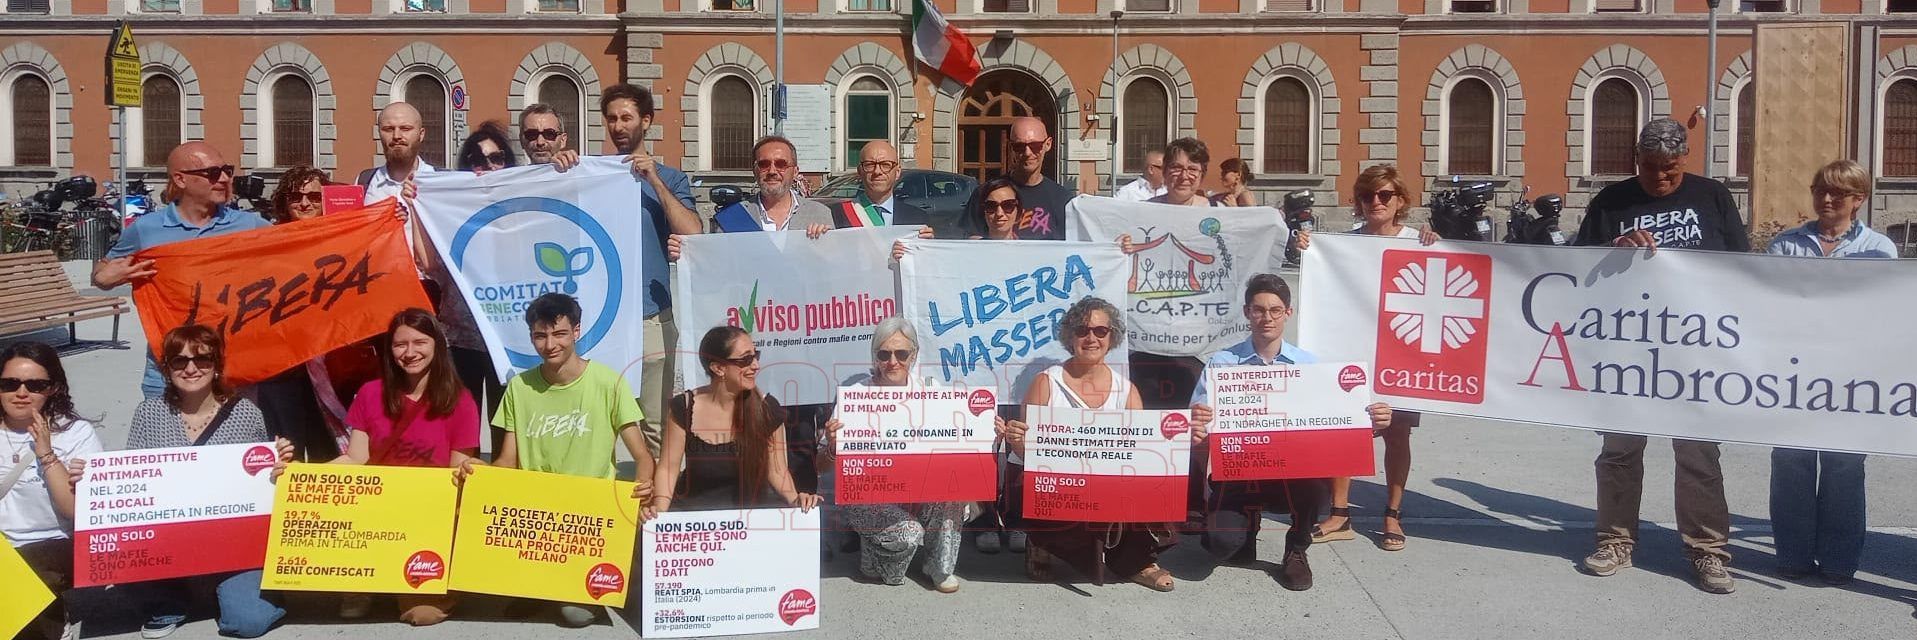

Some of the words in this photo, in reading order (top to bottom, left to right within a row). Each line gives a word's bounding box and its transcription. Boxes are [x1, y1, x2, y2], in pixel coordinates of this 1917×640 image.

[1620, 208, 1699, 235] LIBERA
[928, 255, 1095, 336] LIBERA
[805, 294, 896, 336] pubblico
[1521, 272, 1741, 349] Caritas
[773, 336, 802, 348] Regioni
[804, 336, 828, 345] contro
[858, 334, 873, 342] corr
[938, 308, 1068, 382] MASSER
[1141, 332, 1180, 344] anche
[1183, 335, 1202, 346] per
[1218, 372, 1230, 381] 50
[1232, 370, 1300, 380] INTERDITTIVE
[1517, 321, 1917, 418] Ambrosiana
[1379, 362, 1479, 396] caritas
[1218, 383, 1274, 393] ANTIMAFIA
[844, 392, 890, 400] MINACCE
[892, 392, 904, 400] DI
[906, 392, 938, 400] MORTE
[941, 392, 952, 400] AI
[954, 392, 968, 400] PM
[1218, 396, 1236, 404] NEL
[1238, 396, 1262, 404] 2024
[844, 404, 855, 412] DI
[858, 404, 896, 412] MILANO
[1233, 408, 1268, 416] LOCALI
[1220, 421, 1230, 429] DI
[1296, 418, 1306, 426] IN
[1309, 416, 1352, 426] REGIONE
[844, 430, 881, 438] HYDRA:
[886, 429, 898, 438] 62
[903, 429, 957, 438] CONDANNE
[962, 428, 973, 436] IN
[1037, 424, 1075, 434] HYDRA:
[1078, 426, 1096, 435] 460
[1098, 427, 1140, 436] MILIONI
[1142, 428, 1154, 436] DI
[843, 442, 906, 450] ABBREVIATO
[1036, 436, 1070, 446] DANNI
[1072, 438, 1114, 448] STIMATI
[1116, 440, 1136, 448] PER
[1220, 436, 1242, 445] NON
[1244, 436, 1270, 444] SOLO
[1036, 449, 1098, 459] L'ECONOMIA
[1101, 452, 1132, 460] REALE
[1220, 444, 1244, 453] SUD.
[90, 458, 105, 468] 50
[109, 452, 198, 467] INTERDITTIVE
[842, 458, 864, 468] NON
[866, 458, 893, 467] SOLO
[90, 468, 163, 482] ANTIMAFIA
[842, 467, 866, 476] SUD.
[290, 474, 318, 484] NON
[320, 474, 352, 484] SOLO
[356, 476, 384, 486] SUD.
[1035, 476, 1057, 486] NON
[1059, 478, 1086, 487] SOLO
[90, 487, 112, 496] NEL
[116, 484, 147, 494] 2024
[288, 484, 302, 492] LE
[305, 484, 344, 494] MAFIE
[348, 486, 382, 495] SONO
[1035, 484, 1059, 493] SUD.
[90, 501, 104, 511] 24
[109, 497, 154, 509] LOCALI
[286, 494, 328, 504] ANCHE
[332, 495, 359, 506] QUI.
[90, 516, 103, 526] DI
[189, 508, 202, 517] IN
[205, 503, 255, 516] REGIONE
[310, 511, 320, 520] %
[483, 505, 498, 515] LA
[562, 514, 604, 527] CIVILE
[606, 518, 614, 528] E
[283, 520, 352, 530] OPERAZIONI
[492, 516, 506, 526] LE
[510, 518, 602, 537] ASSOCIAZIONI
[655, 523, 682, 532] NON
[685, 522, 717, 532] SOLO
[720, 520, 748, 530] SUD.
[90, 533, 118, 544] NON
[122, 530, 155, 541] SOLO
[282, 529, 340, 540] SOSPETTE,
[342, 531, 406, 541] LOMBARDIA
[486, 526, 536, 540] STANNO
[540, 534, 554, 542] AL
[558, 534, 606, 548] FIANCO
[655, 534, 668, 542] LE
[672, 532, 710, 542] MAFIE
[714, 531, 748, 541] SONO
[90, 542, 120, 553] SUD.
[280, 538, 314, 548] PRIMA
[317, 539, 329, 548] IN
[332, 540, 368, 549] ITALIA
[485, 536, 522, 549] DELLA
[526, 541, 586, 556] PROCURA
[589, 548, 604, 558] DI
[655, 542, 697, 553] ANCHE
[700, 542, 726, 554] QUI.
[109, 548, 149, 560] MAFIE
[518, 550, 568, 564] MILANO
[90, 560, 126, 572] SONO
[130, 556, 173, 568] ANCHE
[277, 556, 308, 566] 2.616
[655, 560, 668, 568] LO
[672, 558, 714, 568] DICONO
[276, 566, 302, 575] BENI
[306, 566, 375, 577] CONFISCATI
[655, 569, 660, 578] I
[662, 568, 688, 577] DATI
[655, 588, 680, 596] REATI
[704, 586, 744, 594] Lombardia
[746, 586, 768, 594] prima
[655, 596, 674, 604] Italia
[655, 615, 705, 624] ESTORSIONI
[707, 614, 736, 623] rispetto
[746, 612, 774, 620] periodo
[655, 622, 712, 632] pre-pandemico
